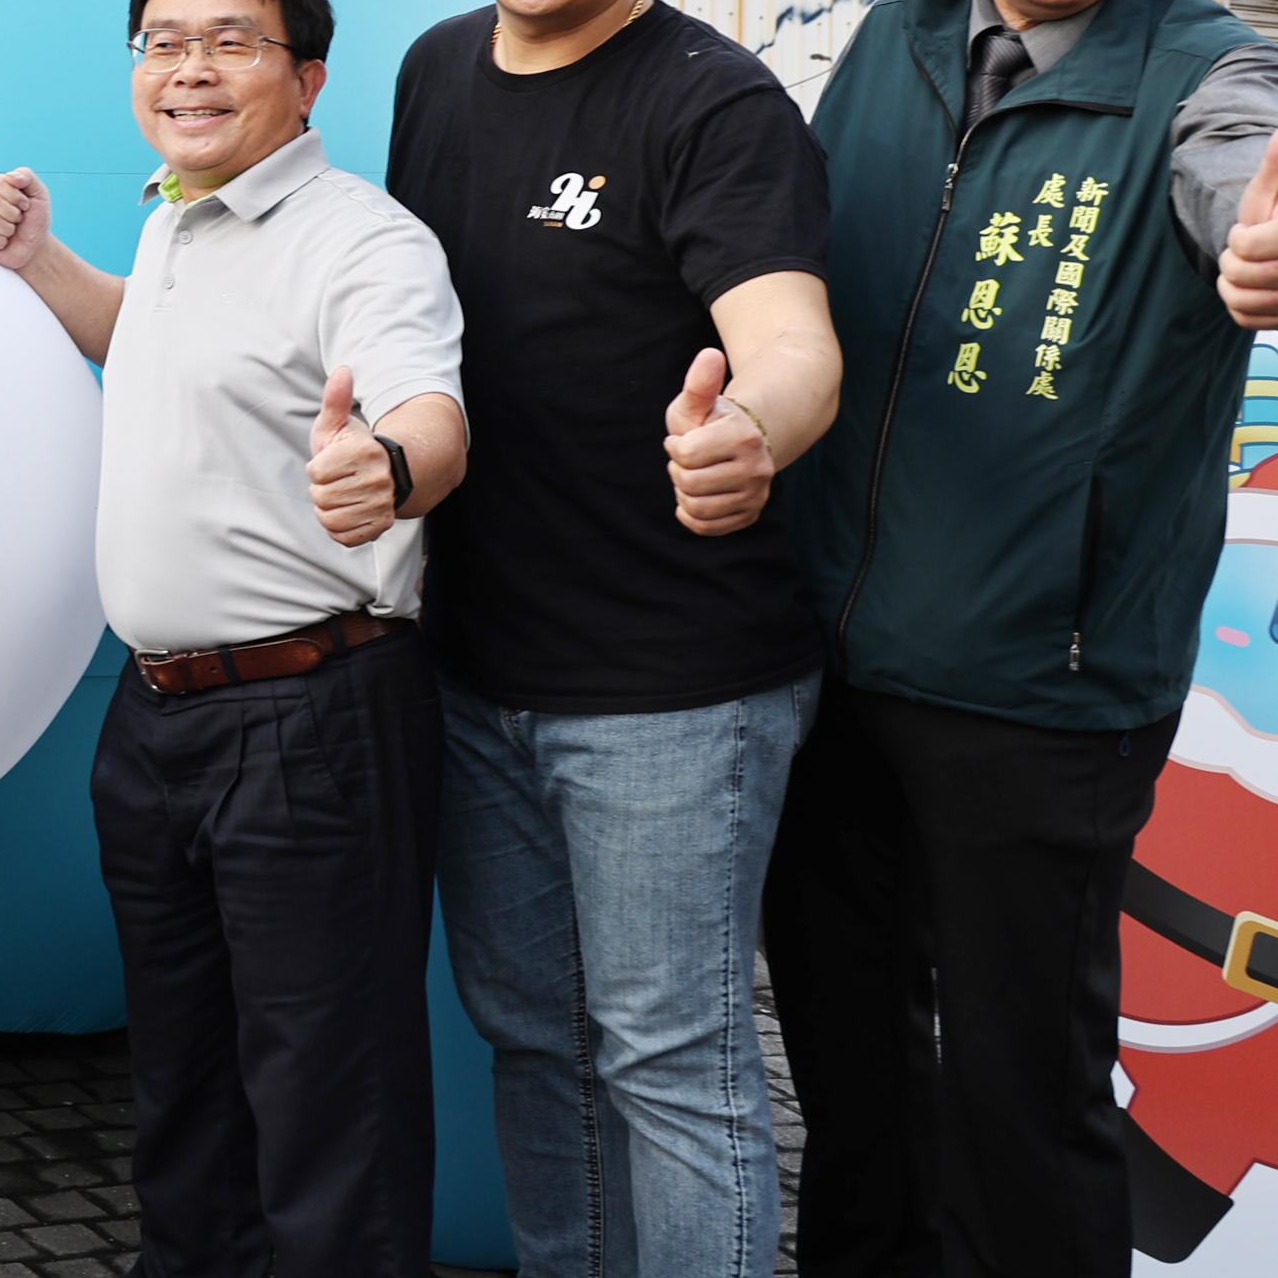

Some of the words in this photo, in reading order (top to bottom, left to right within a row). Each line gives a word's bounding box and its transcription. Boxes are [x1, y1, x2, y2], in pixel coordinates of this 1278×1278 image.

[1025, 176, 1109, 400] 新聞及國際關係處
[1027, 172, 1067, 247] 處長
[947, 211, 1025, 394] 蘇恩恩
